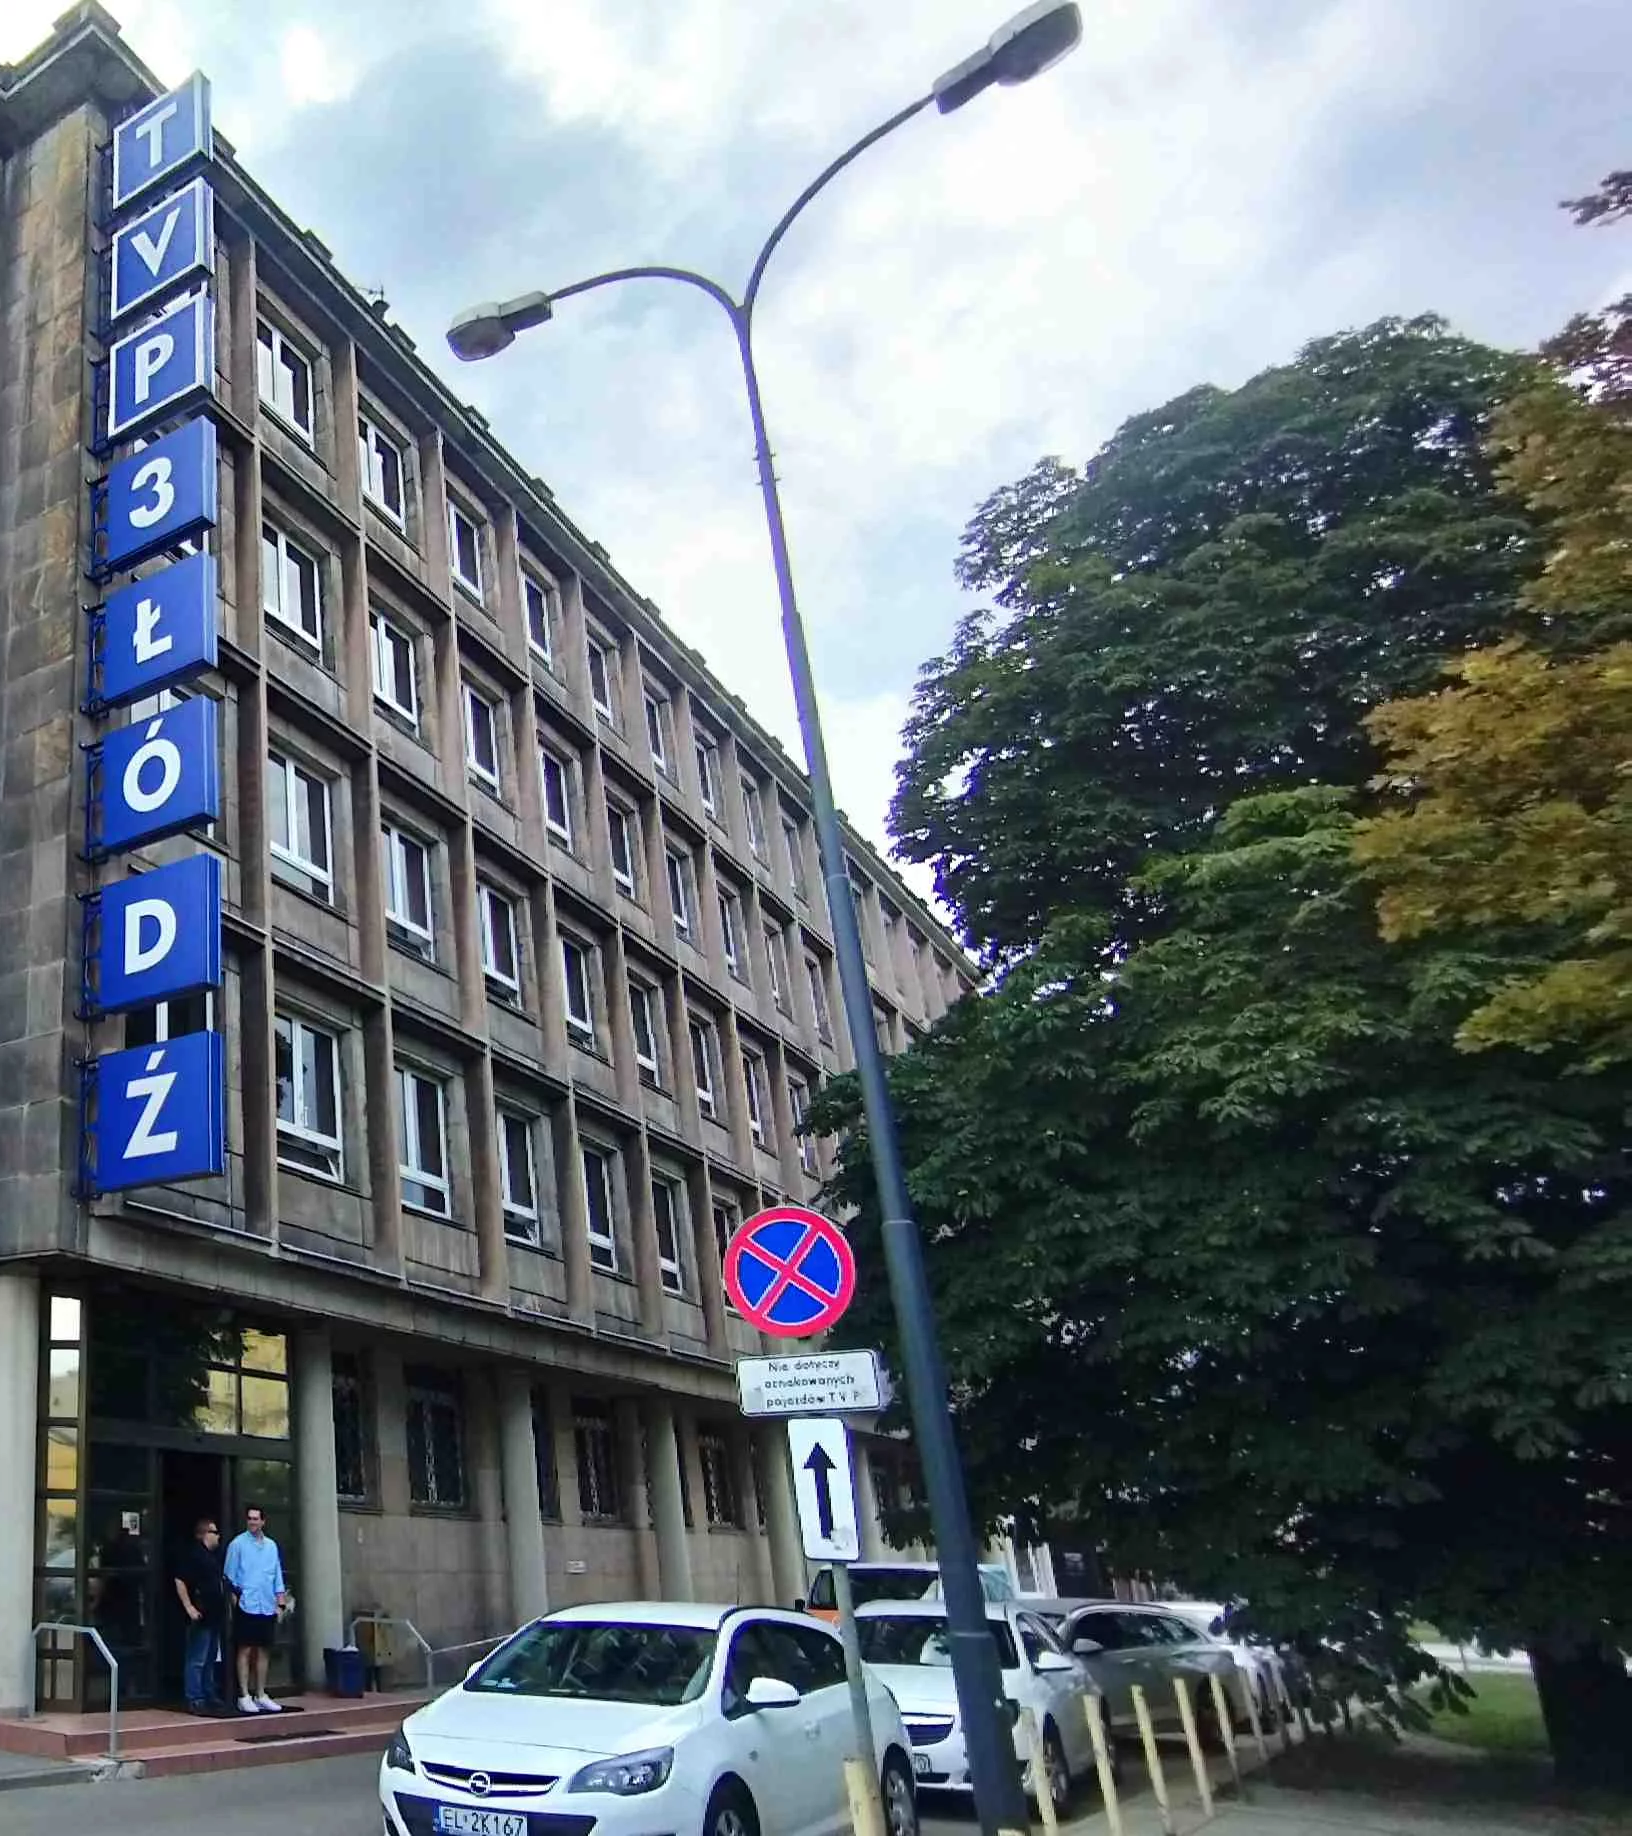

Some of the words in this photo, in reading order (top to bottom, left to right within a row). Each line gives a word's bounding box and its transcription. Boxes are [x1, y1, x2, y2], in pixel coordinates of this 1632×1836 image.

[768, 1361, 788, 1373] Nie
[794, 1359, 840, 1372] dotyczy
[443, 1807, 463, 1829] EL
